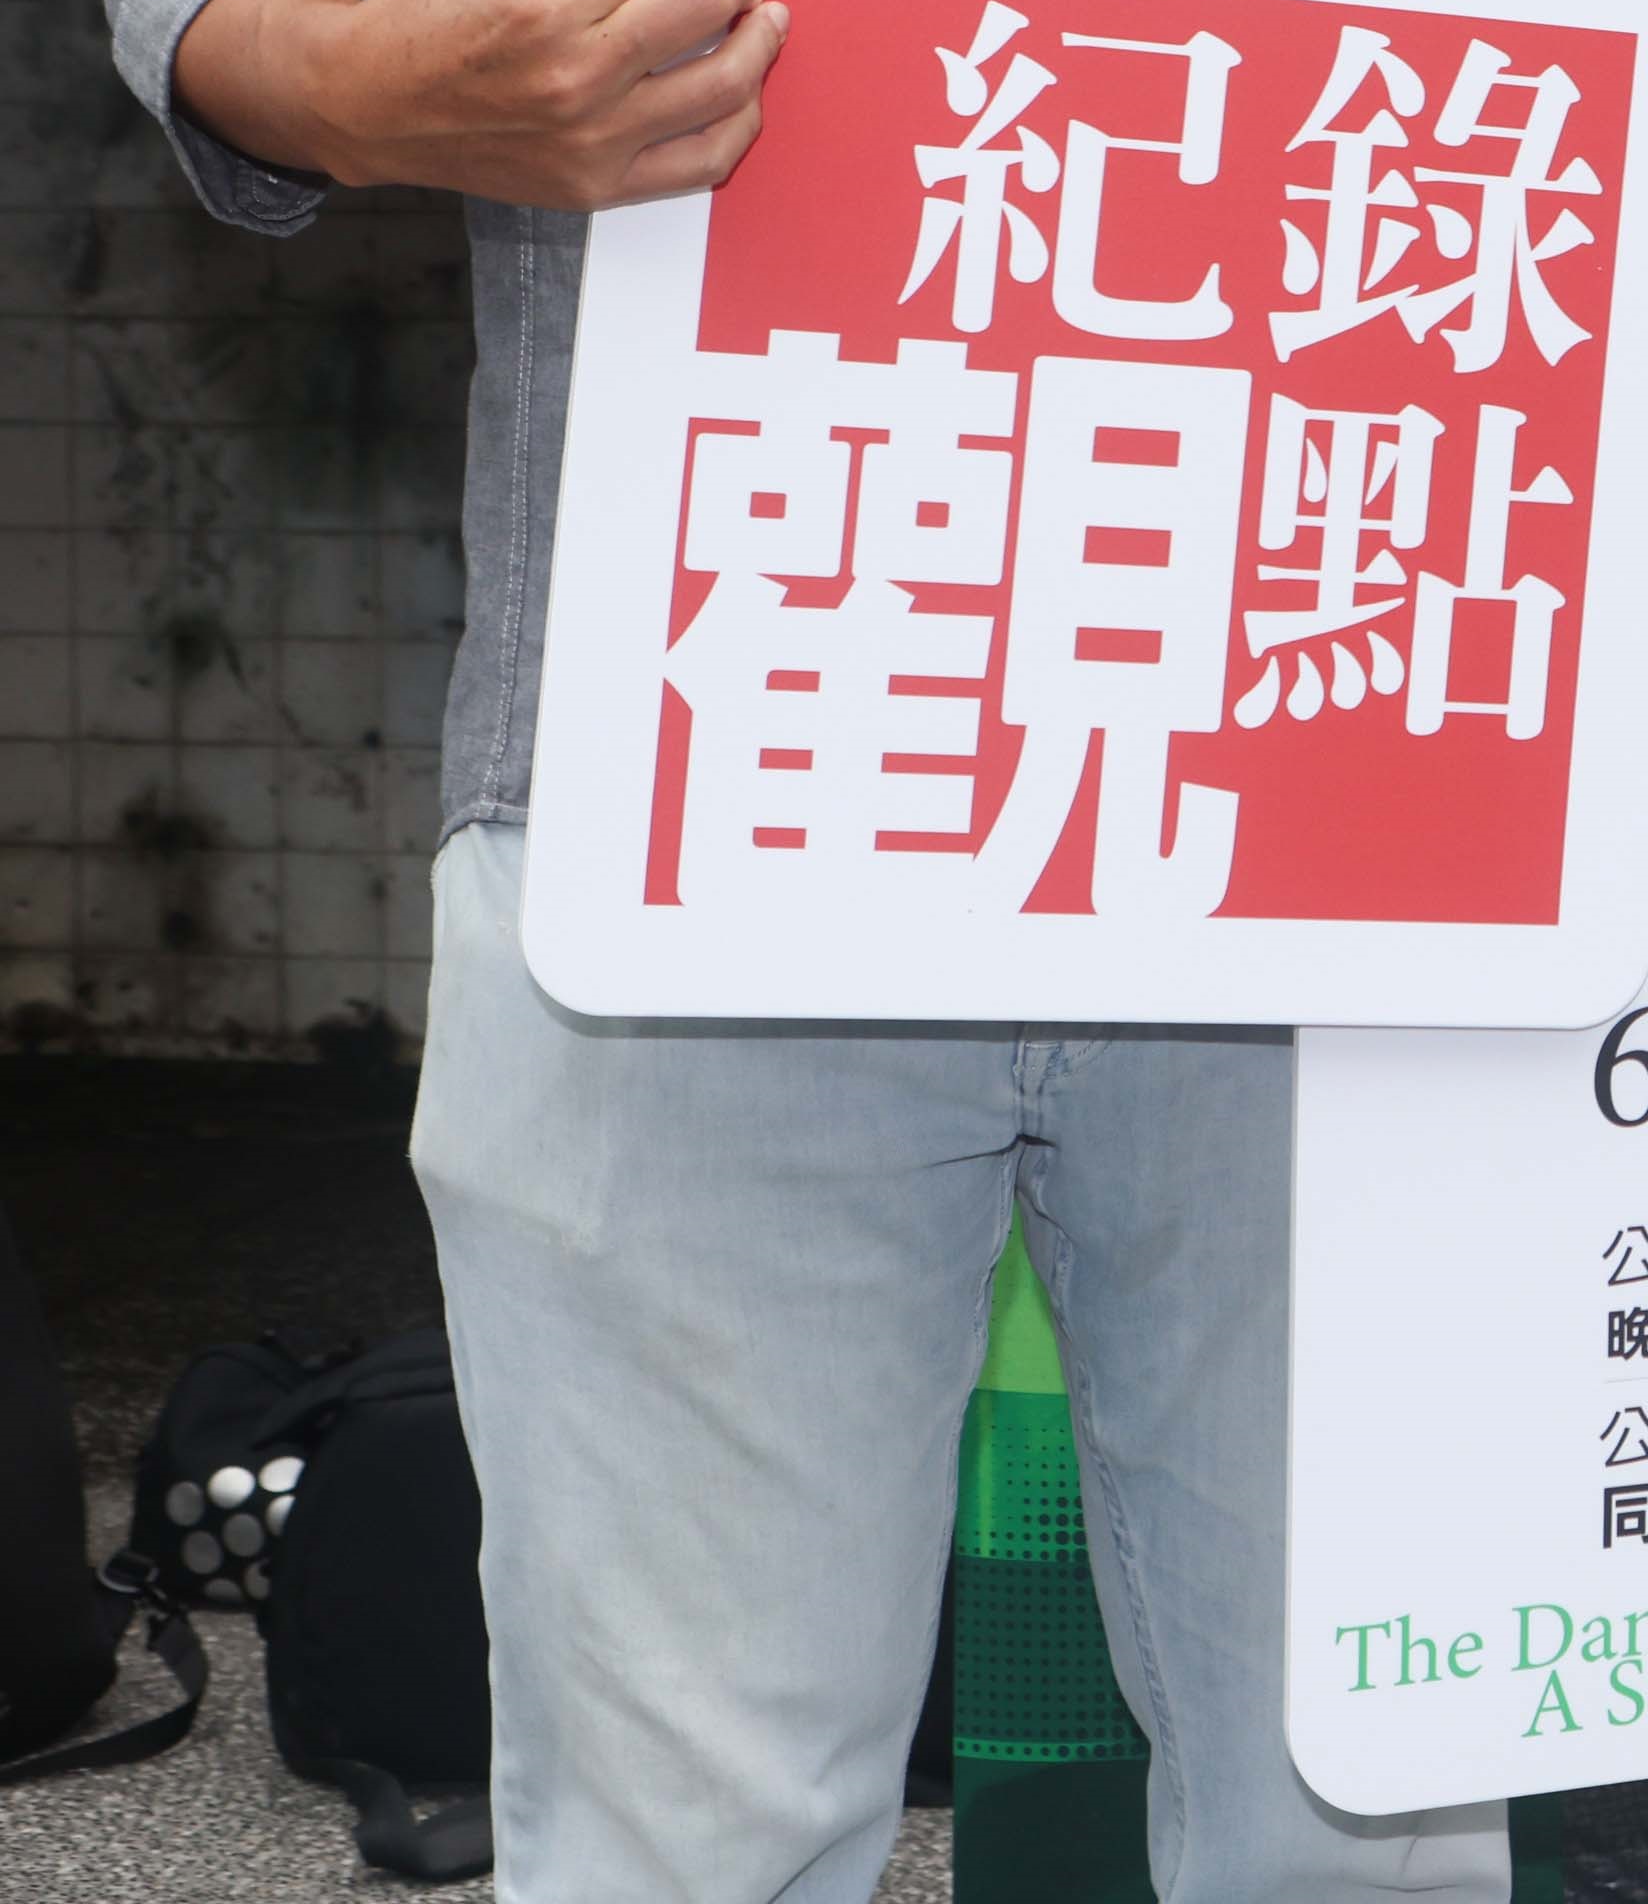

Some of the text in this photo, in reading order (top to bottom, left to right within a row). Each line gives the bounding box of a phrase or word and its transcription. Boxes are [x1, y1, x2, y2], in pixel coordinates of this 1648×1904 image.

[898, 0, 1603, 376] 紀錄
[1336, 1614, 1484, 1693] The
[1521, 1670, 1584, 1738] A
